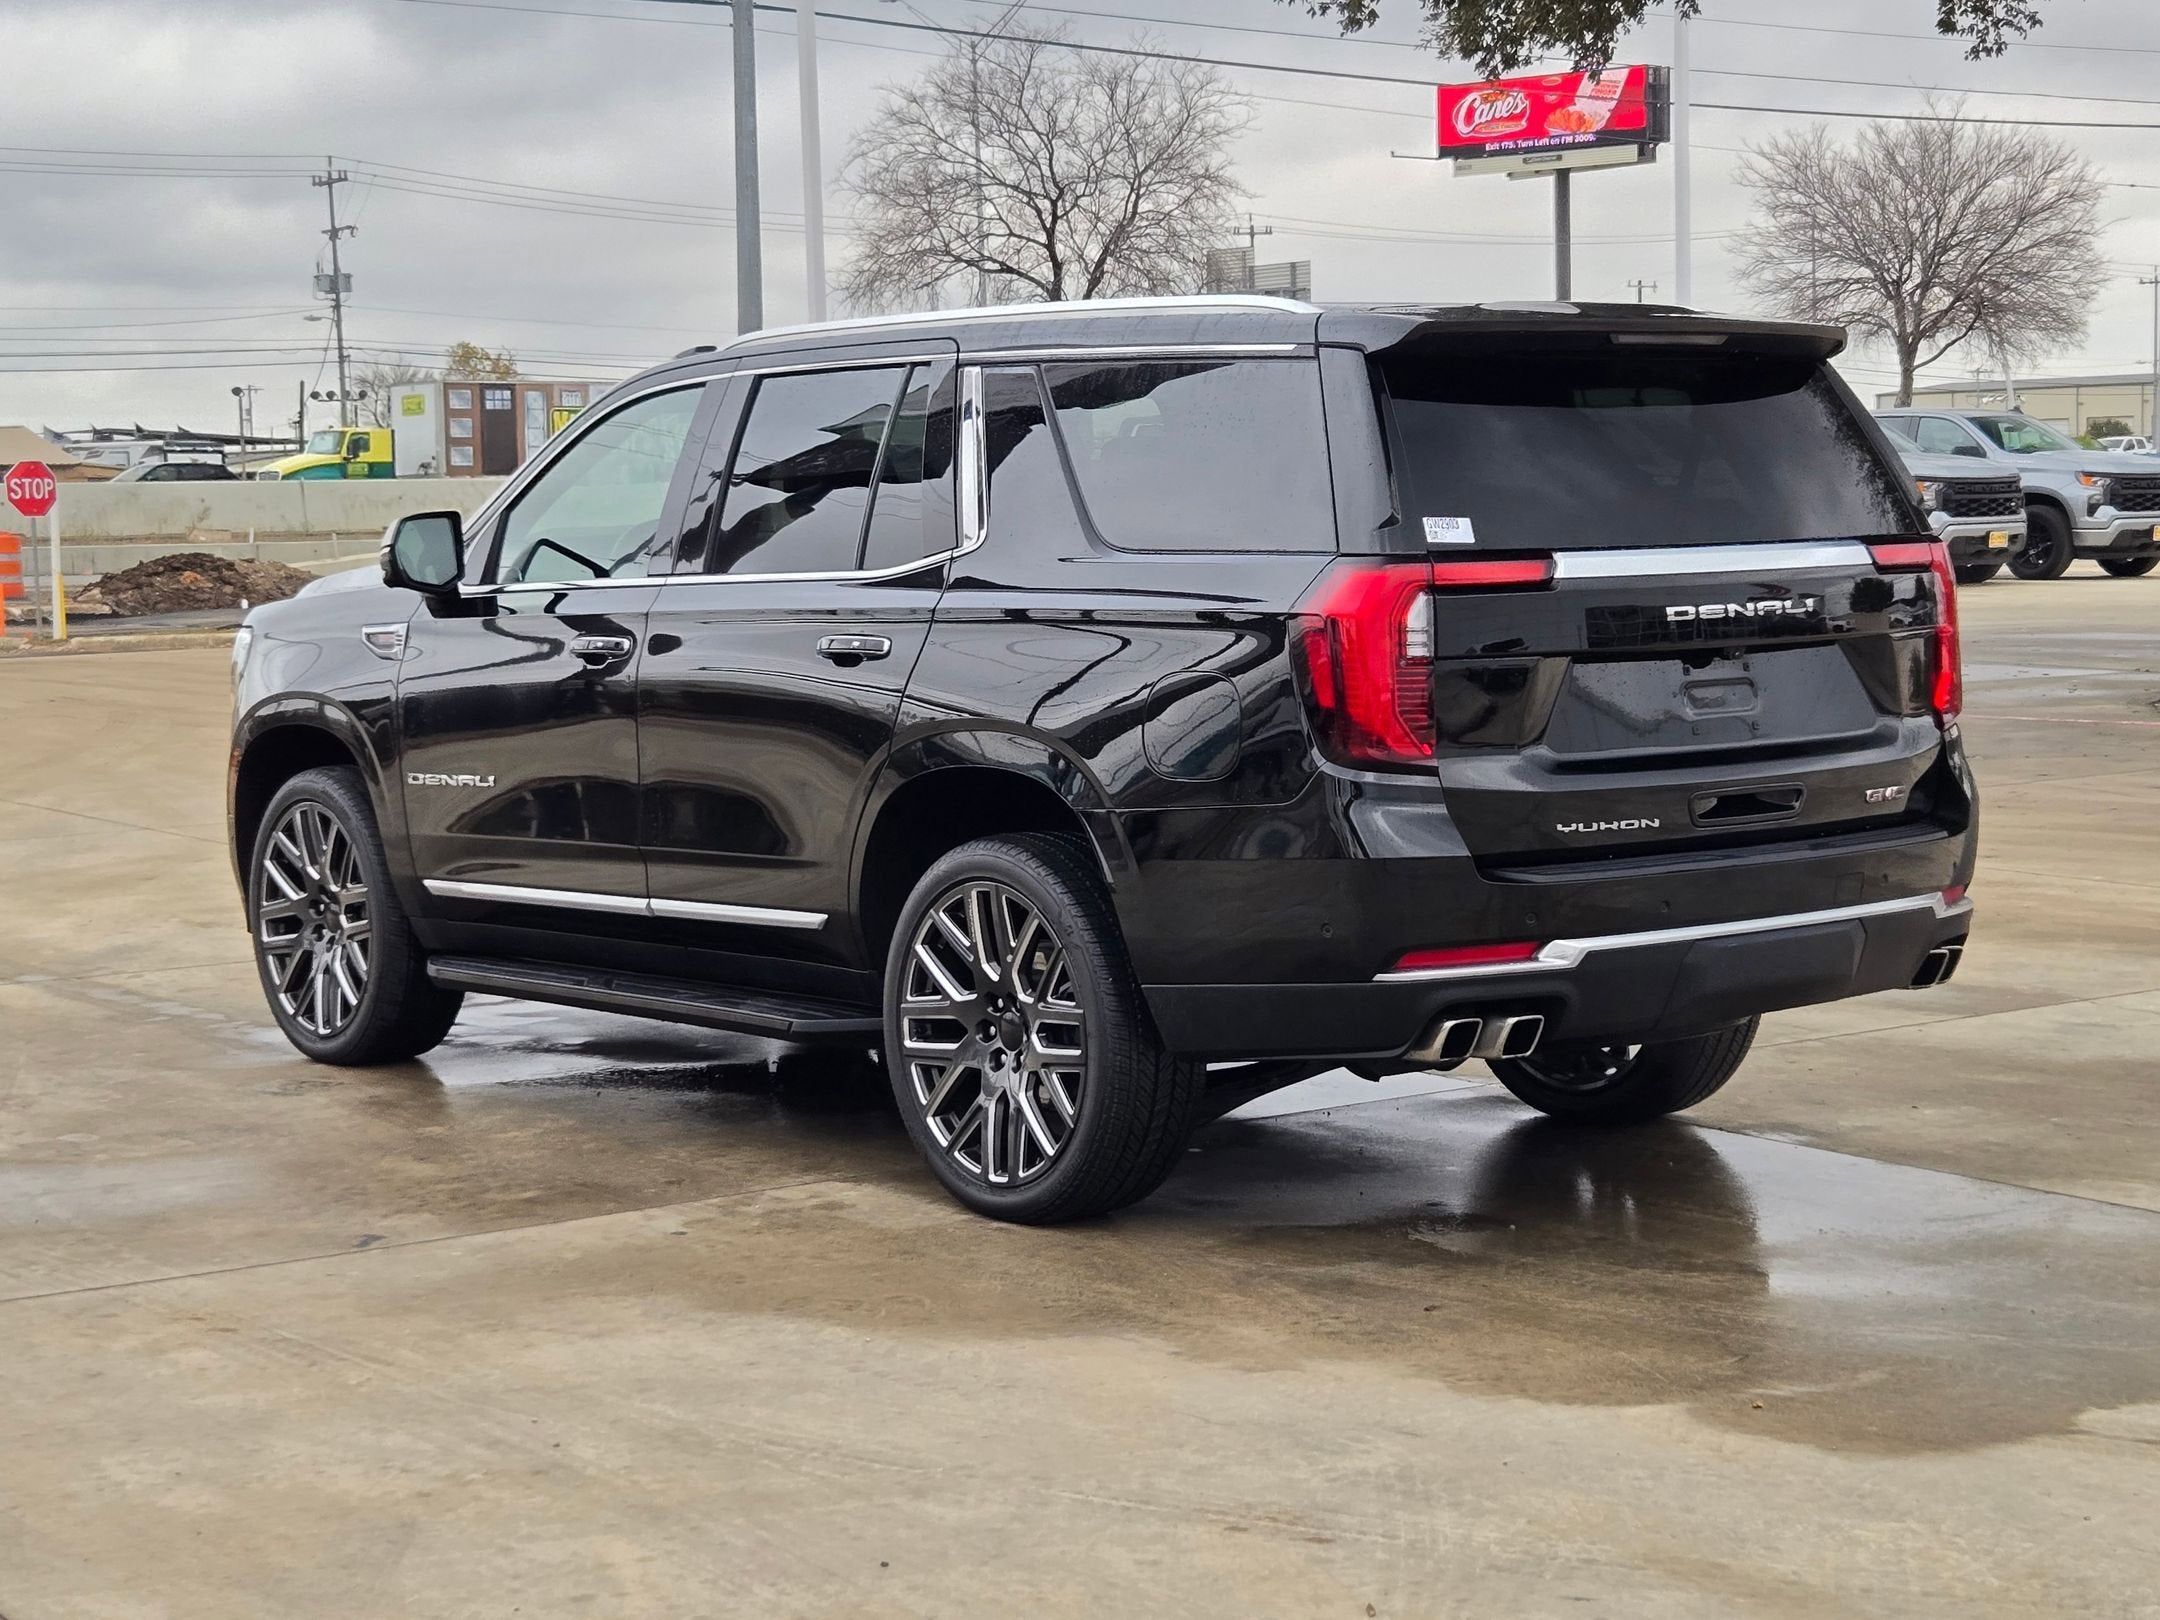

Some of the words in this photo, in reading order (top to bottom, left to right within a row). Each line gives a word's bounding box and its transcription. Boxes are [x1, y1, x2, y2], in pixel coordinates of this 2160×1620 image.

[1485, 143, 1500, 151] Exit
[1517, 140, 1534, 148] Turn
[1534, 138, 1550, 146] Left
[9, 478, 54, 499] STOP
[1665, 597, 1817, 622] DENALI
[407, 772, 496, 787] DENALI
[1556, 818, 1660, 833] YUKON
